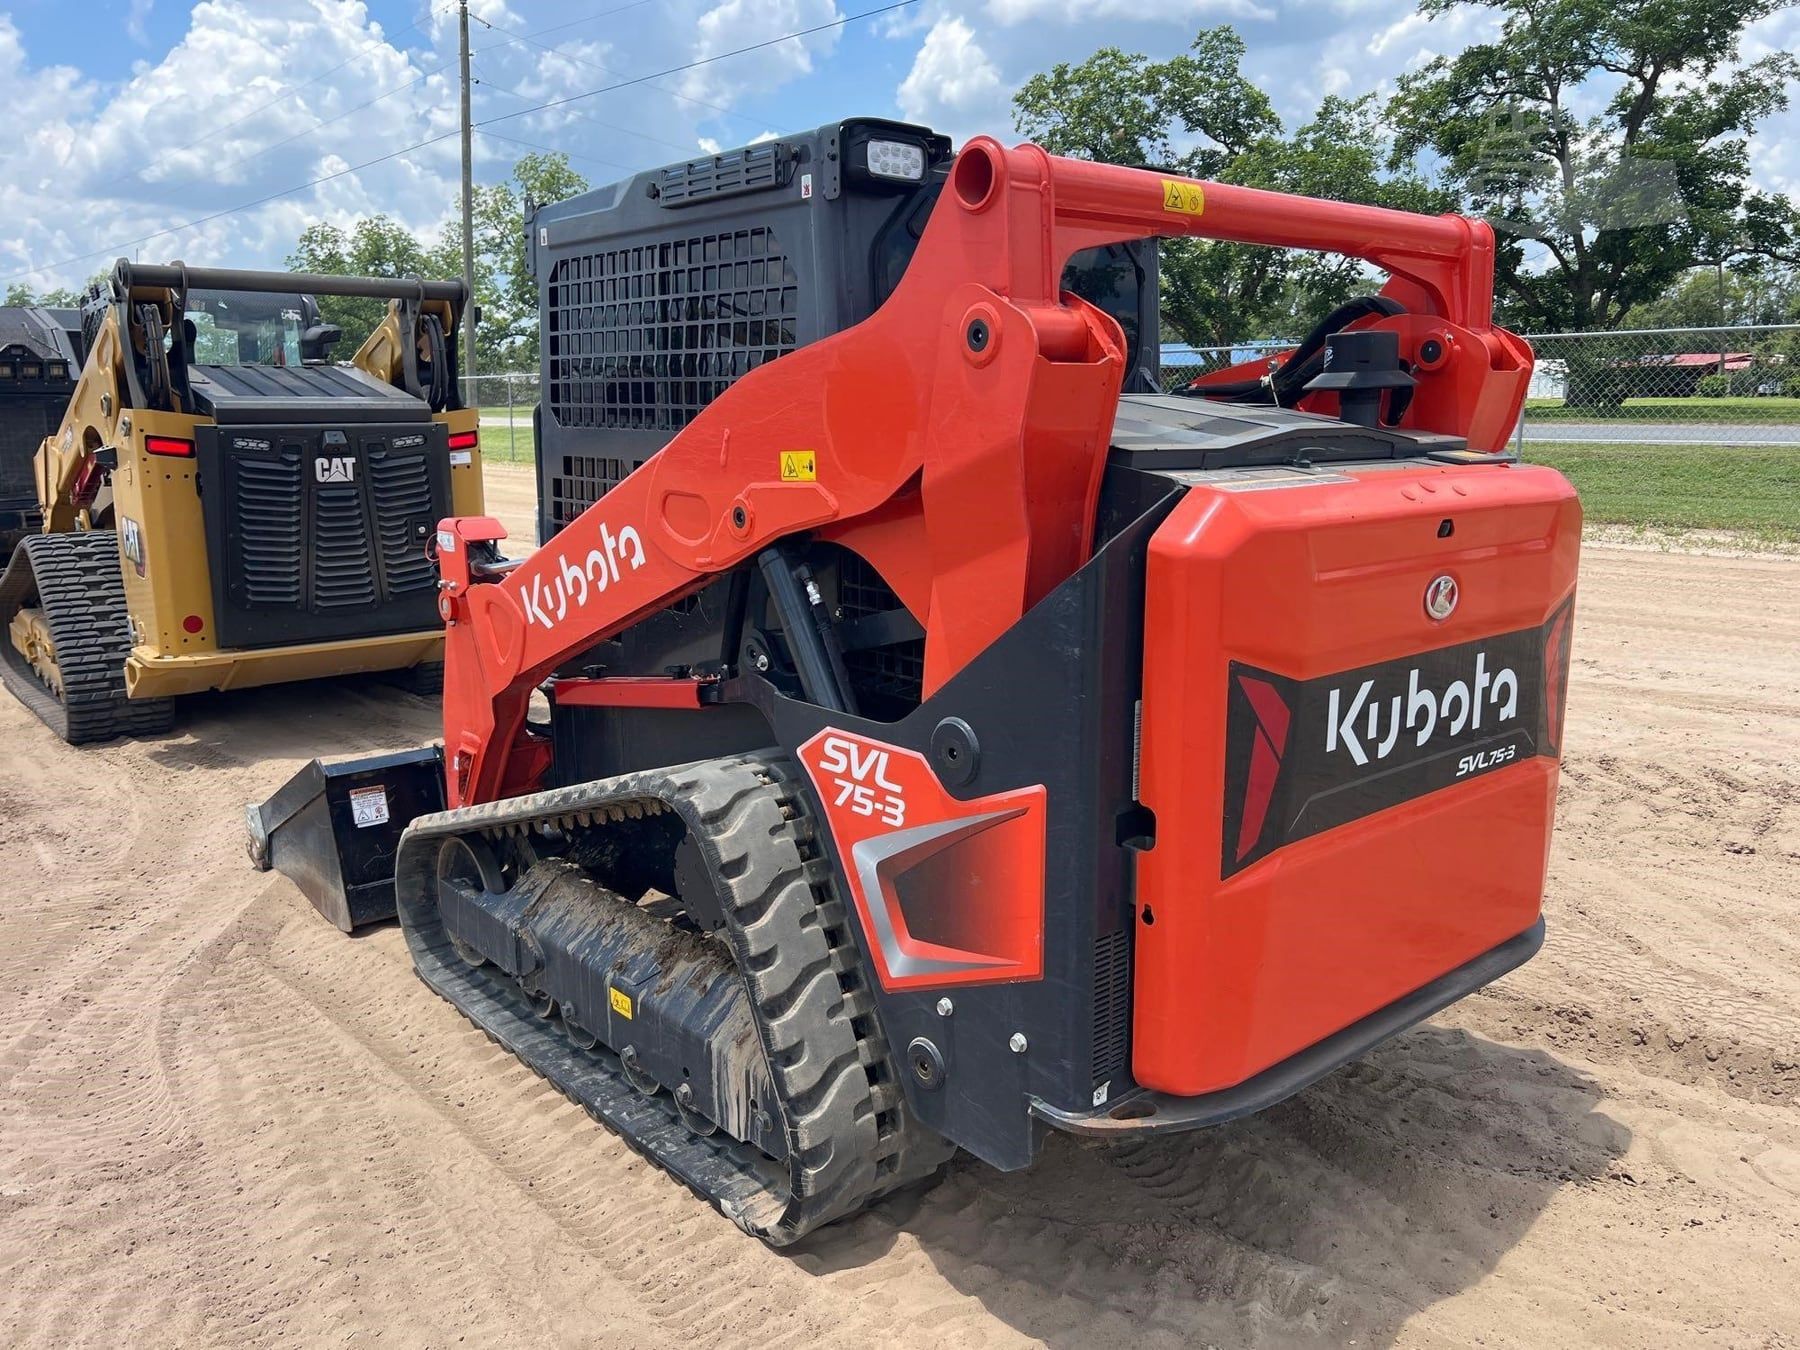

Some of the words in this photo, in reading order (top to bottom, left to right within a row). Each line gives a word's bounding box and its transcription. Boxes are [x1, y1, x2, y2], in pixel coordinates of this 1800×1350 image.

[314, 457, 356, 483] CAT
[122, 516, 141, 563] CAT
[520, 522, 647, 630] Kubota
[1326, 652, 1518, 766] Kubota
[819, 736, 902, 794] SVL
[833, 777, 906, 828] 75-3
